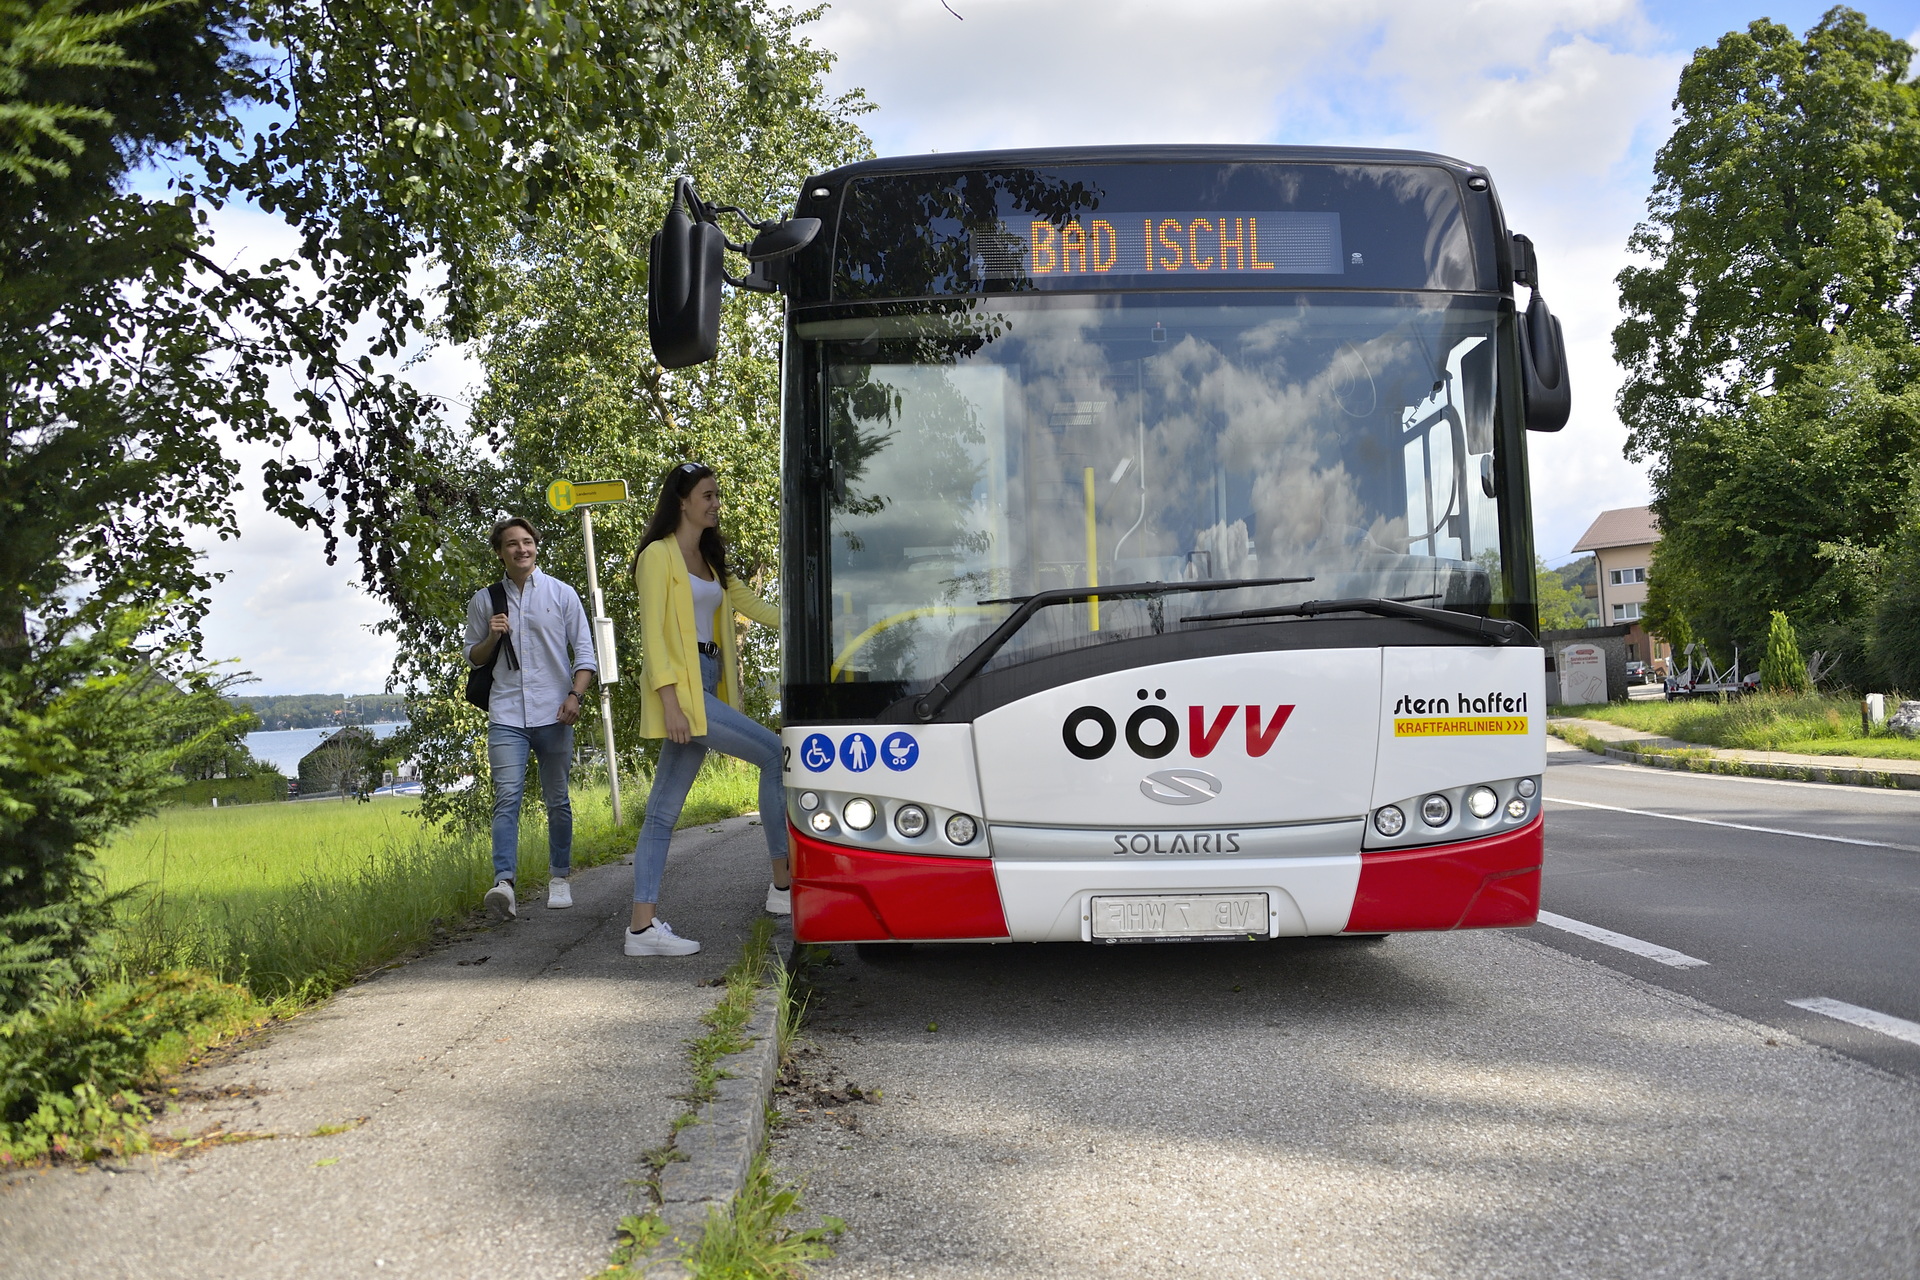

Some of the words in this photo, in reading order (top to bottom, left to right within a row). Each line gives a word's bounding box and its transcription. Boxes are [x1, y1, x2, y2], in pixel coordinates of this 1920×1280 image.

[1031, 219, 1117, 274] BAD
[1144, 217, 1275, 272] ISCHL
[554, 485, 572, 506] H
[1394, 694, 1450, 715] stern
[1457, 692, 1528, 714] hafferl
[1062, 688, 1296, 760] OÖVV
[1397, 720, 1503, 734] KRAFTFAHRLINIEN
[1113, 832, 1241, 855] SOLARIS
